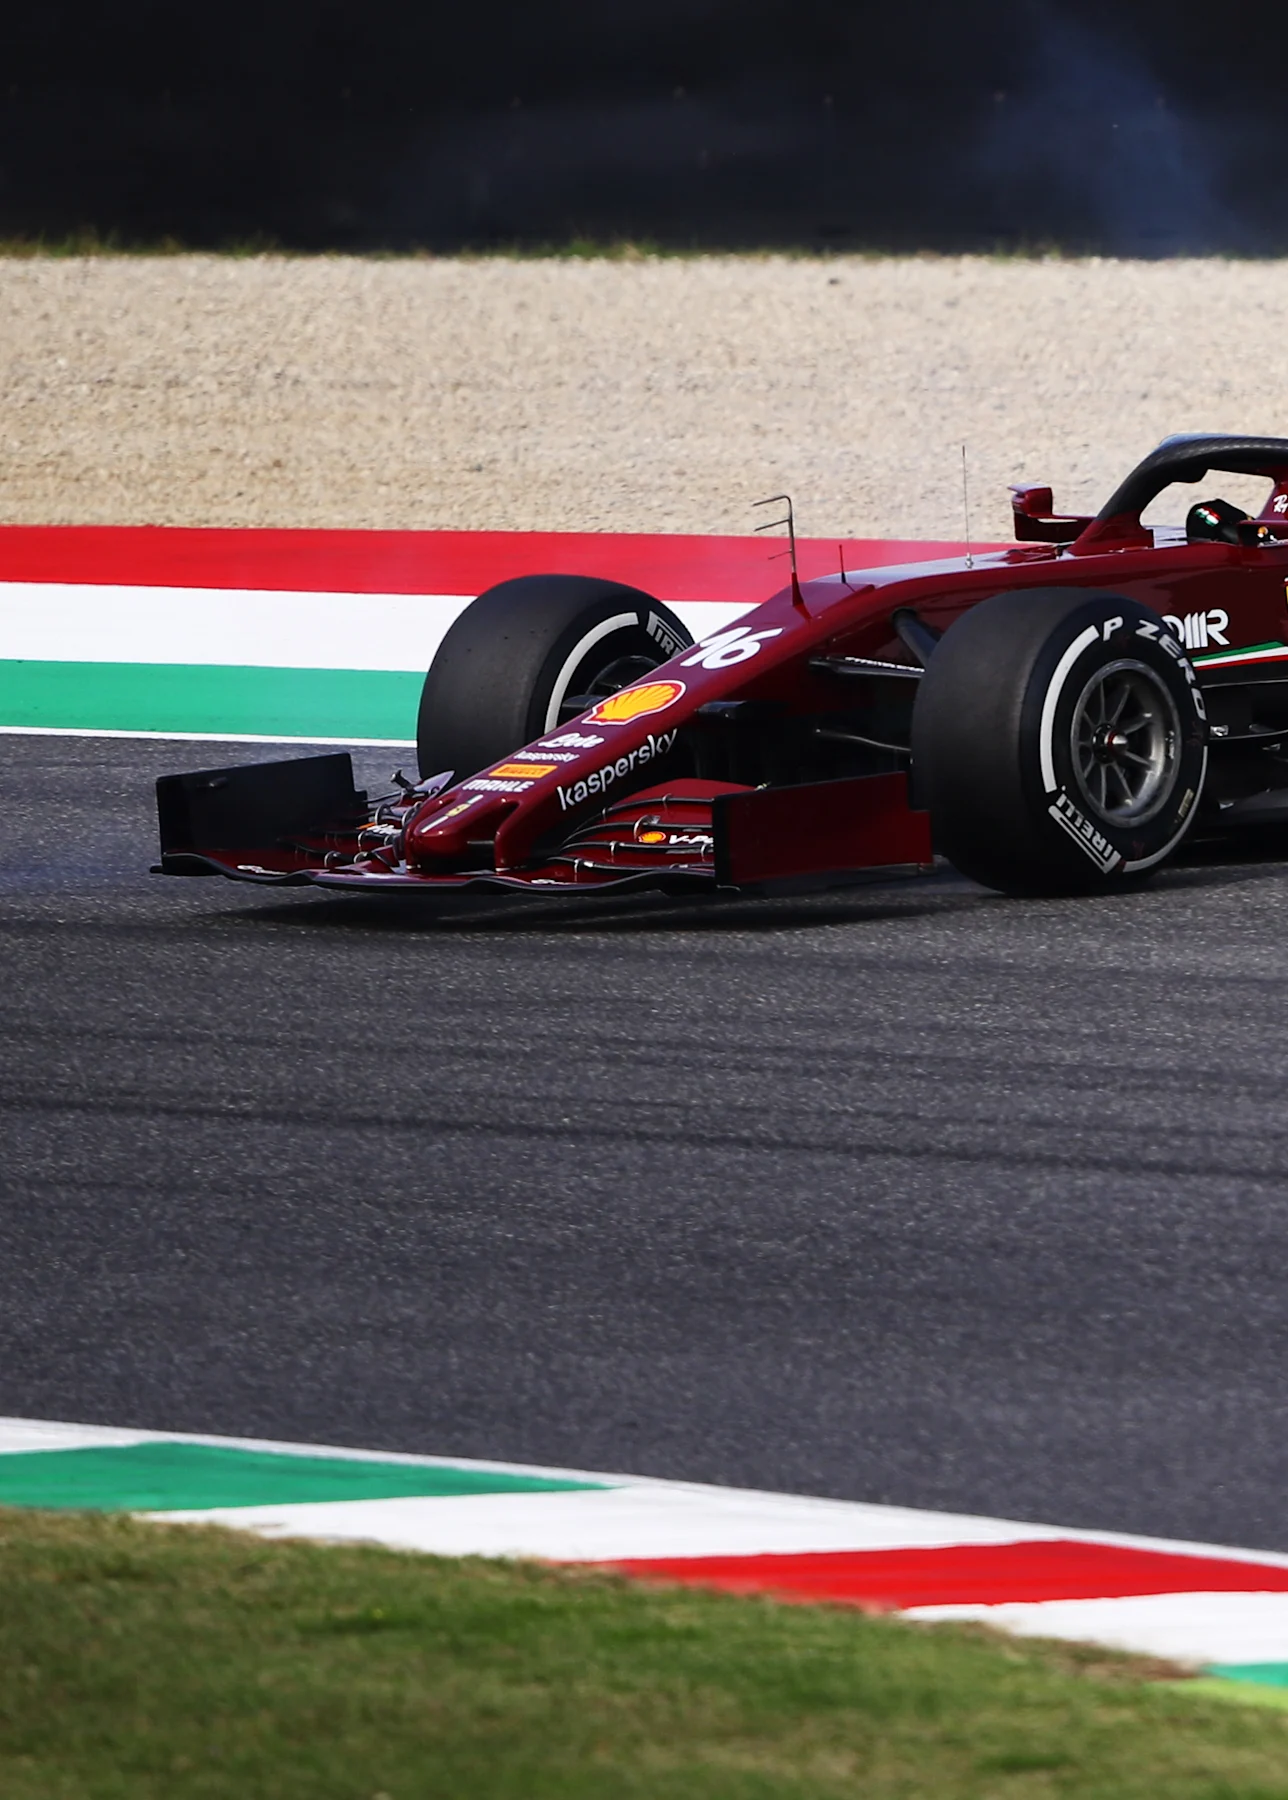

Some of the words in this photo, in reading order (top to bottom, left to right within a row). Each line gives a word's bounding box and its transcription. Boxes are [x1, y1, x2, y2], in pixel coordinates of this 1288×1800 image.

[680, 626, 784, 670] 16
[1103, 615, 1124, 642] P
[1134, 619, 1208, 721] ZERO
[462, 778, 535, 793] MAHLE
[514, 750, 580, 763] kaspersky
[556, 728, 678, 811] kaspersky
[1048, 792, 1122, 874] PIRELLI
